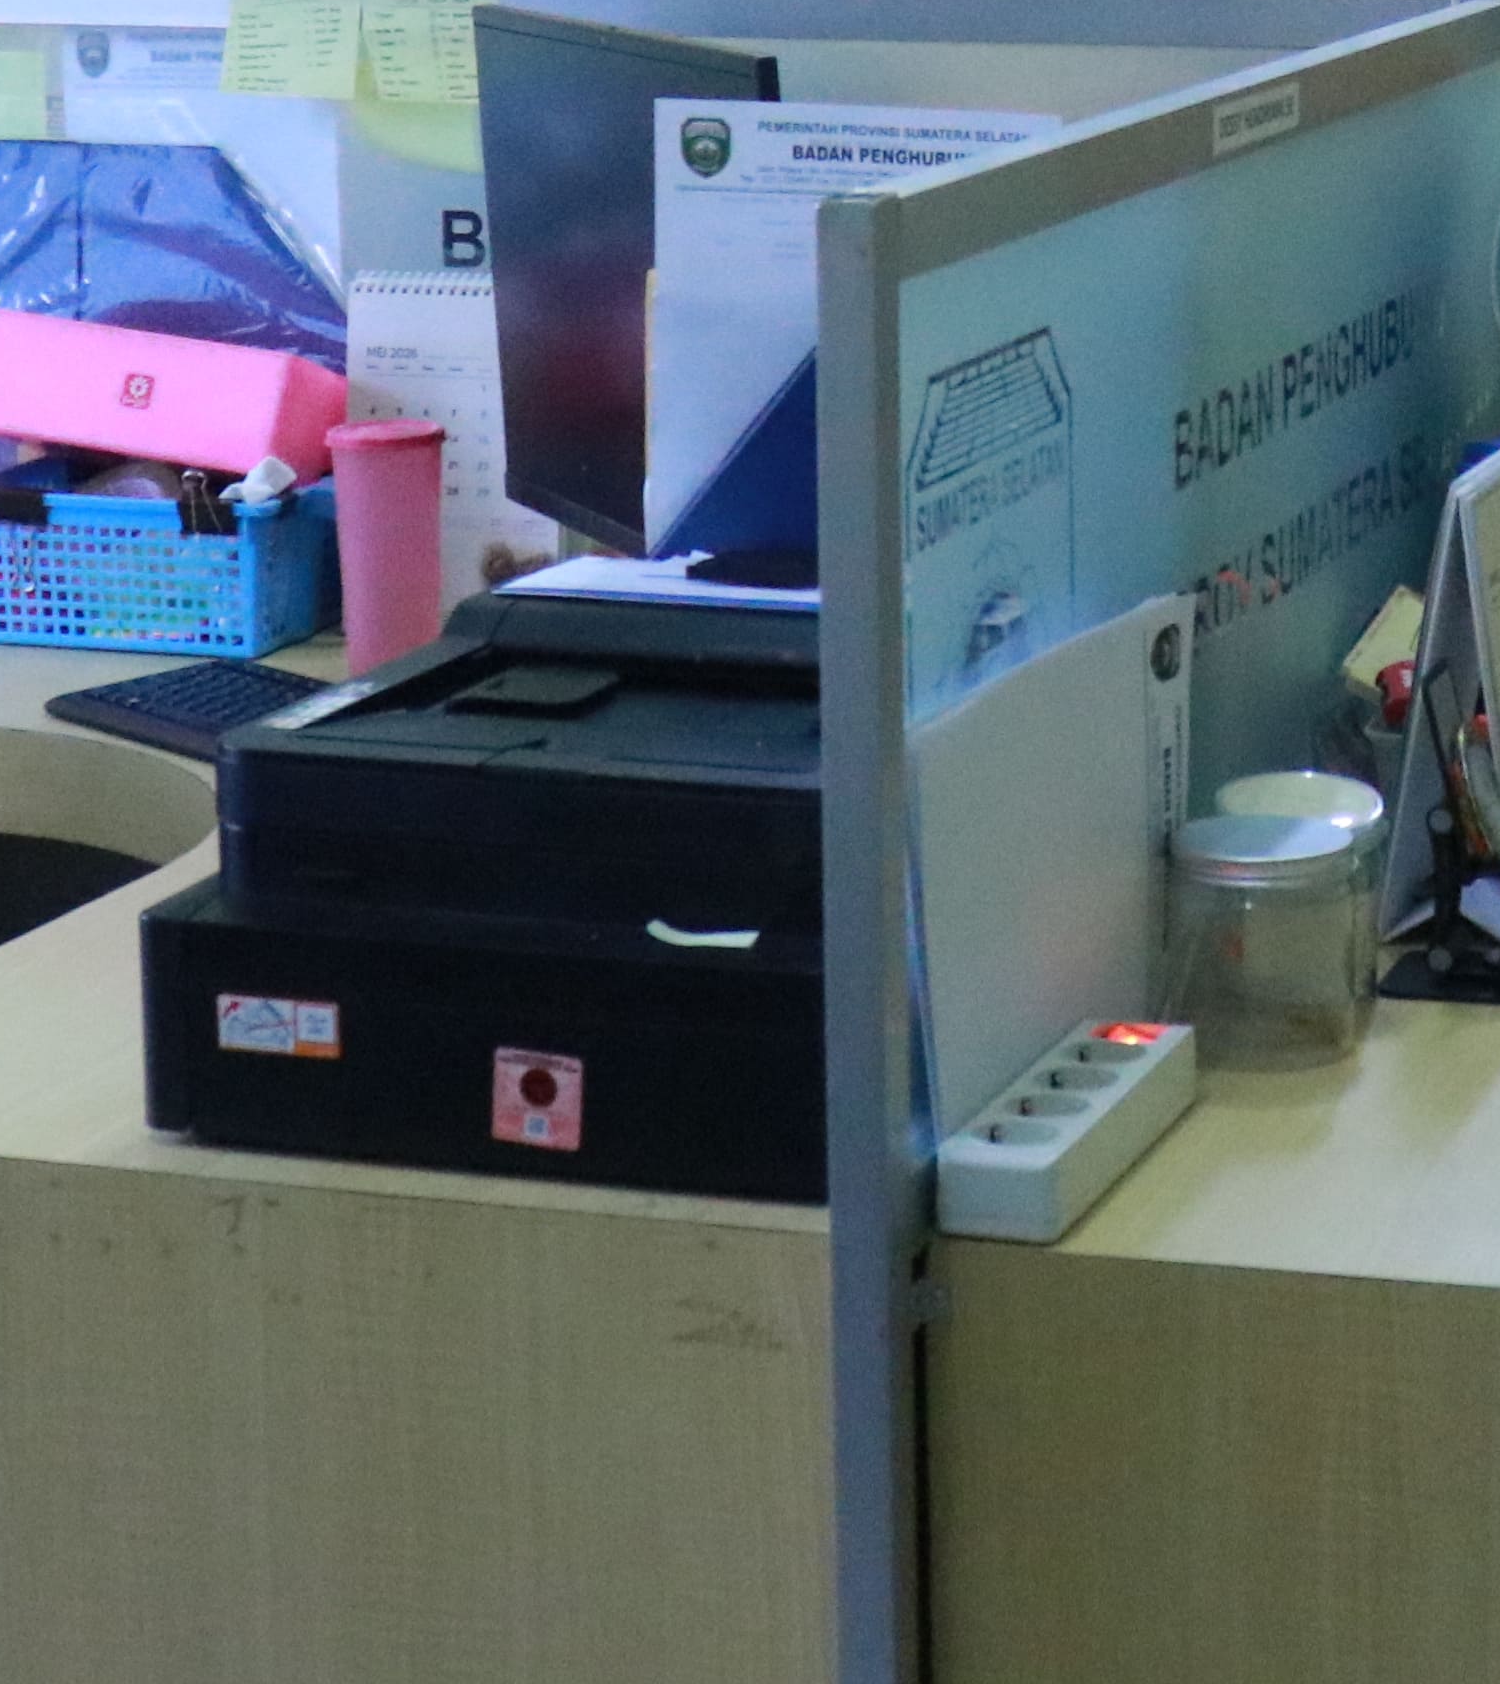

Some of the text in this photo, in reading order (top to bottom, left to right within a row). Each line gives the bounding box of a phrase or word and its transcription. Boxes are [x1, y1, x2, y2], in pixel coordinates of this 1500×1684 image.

[757, 120, 839, 135] PEMERINTAH
[841, 123, 901, 138] PROVINSI
[904, 126, 971, 142] SUMATERA
[792, 144, 854, 163] BADAN
[366, 346, 387, 359] MEI
[1174, 364, 1274, 491] BADAN
